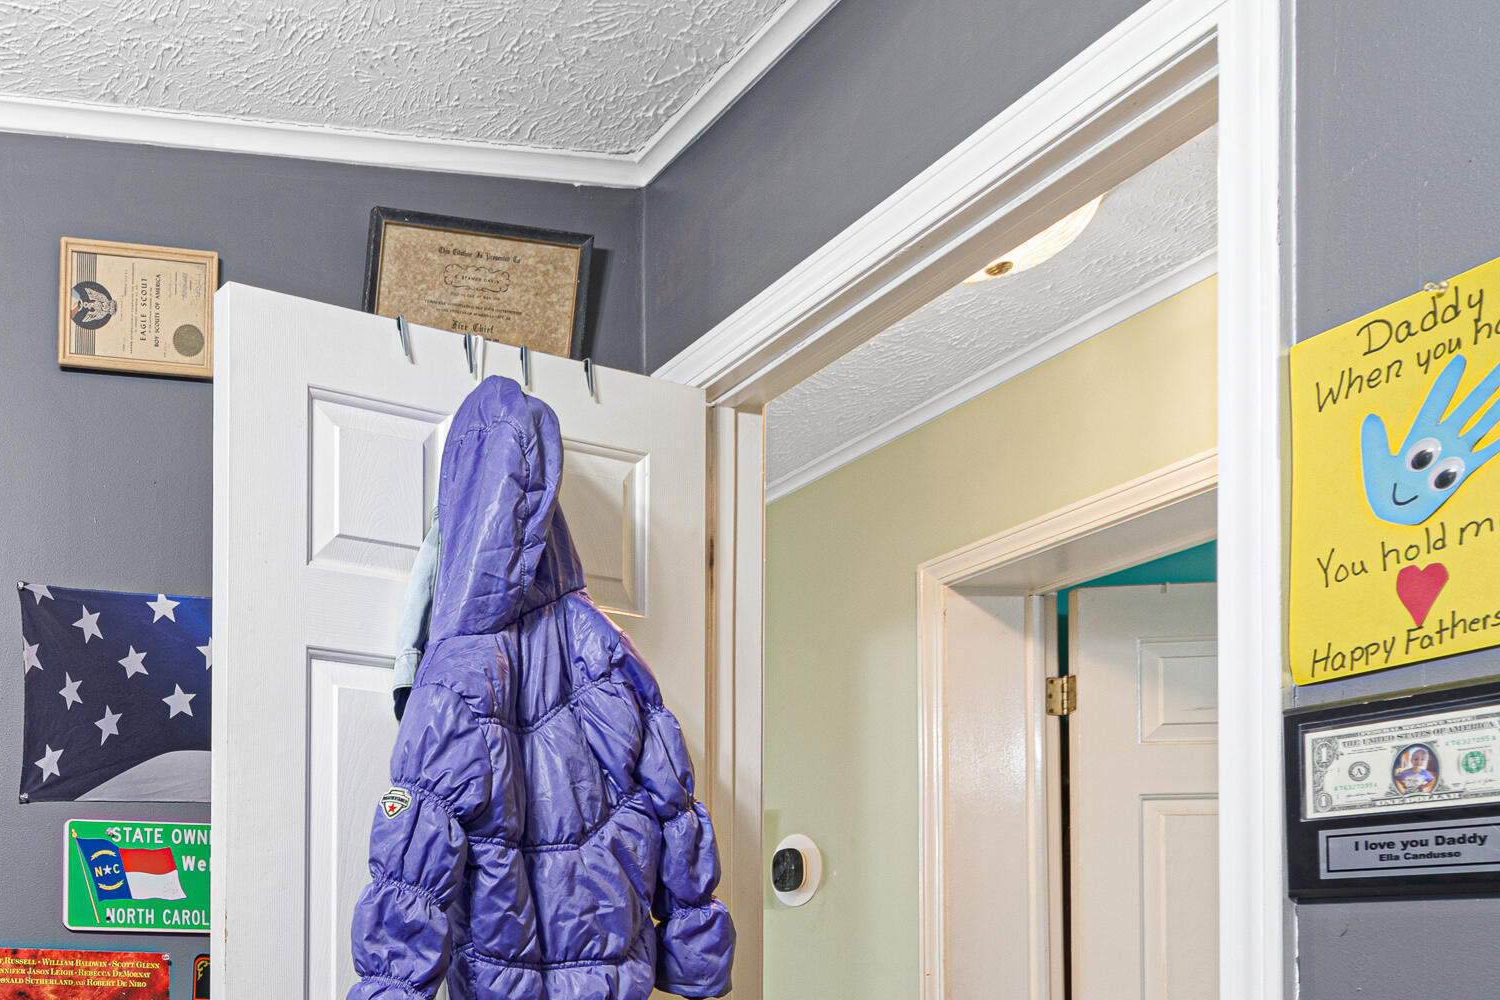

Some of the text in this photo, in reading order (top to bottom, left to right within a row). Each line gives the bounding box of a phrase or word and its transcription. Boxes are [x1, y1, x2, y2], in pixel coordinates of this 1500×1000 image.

[156, 302, 160, 310] OF
[452, 320, 494, 334] Fire Chief
[1357, 286, 1484, 356] Daddy
[1315, 334, 1461, 413] When you
[1317, 521, 1446, 588] You hold
[1311, 634, 1397, 679] Happy
[1343, 740, 1360, 748] THE
[1363, 735, 1394, 746] UNITED
[1397, 730, 1430, 740] STATES
[1433, 727, 1446, 735] OF
[1448, 721, 1494, 734] AMERICA
[111, 827, 211, 845] STATE OWN
[1354, 833, 1488, 850] I love you Daddy
[182, 856, 211, 872] We
[1379, 851, 1462, 862] Ella Candusso
[94, 864, 120, 878] N C
[106, 908, 154, 924] NORTH
